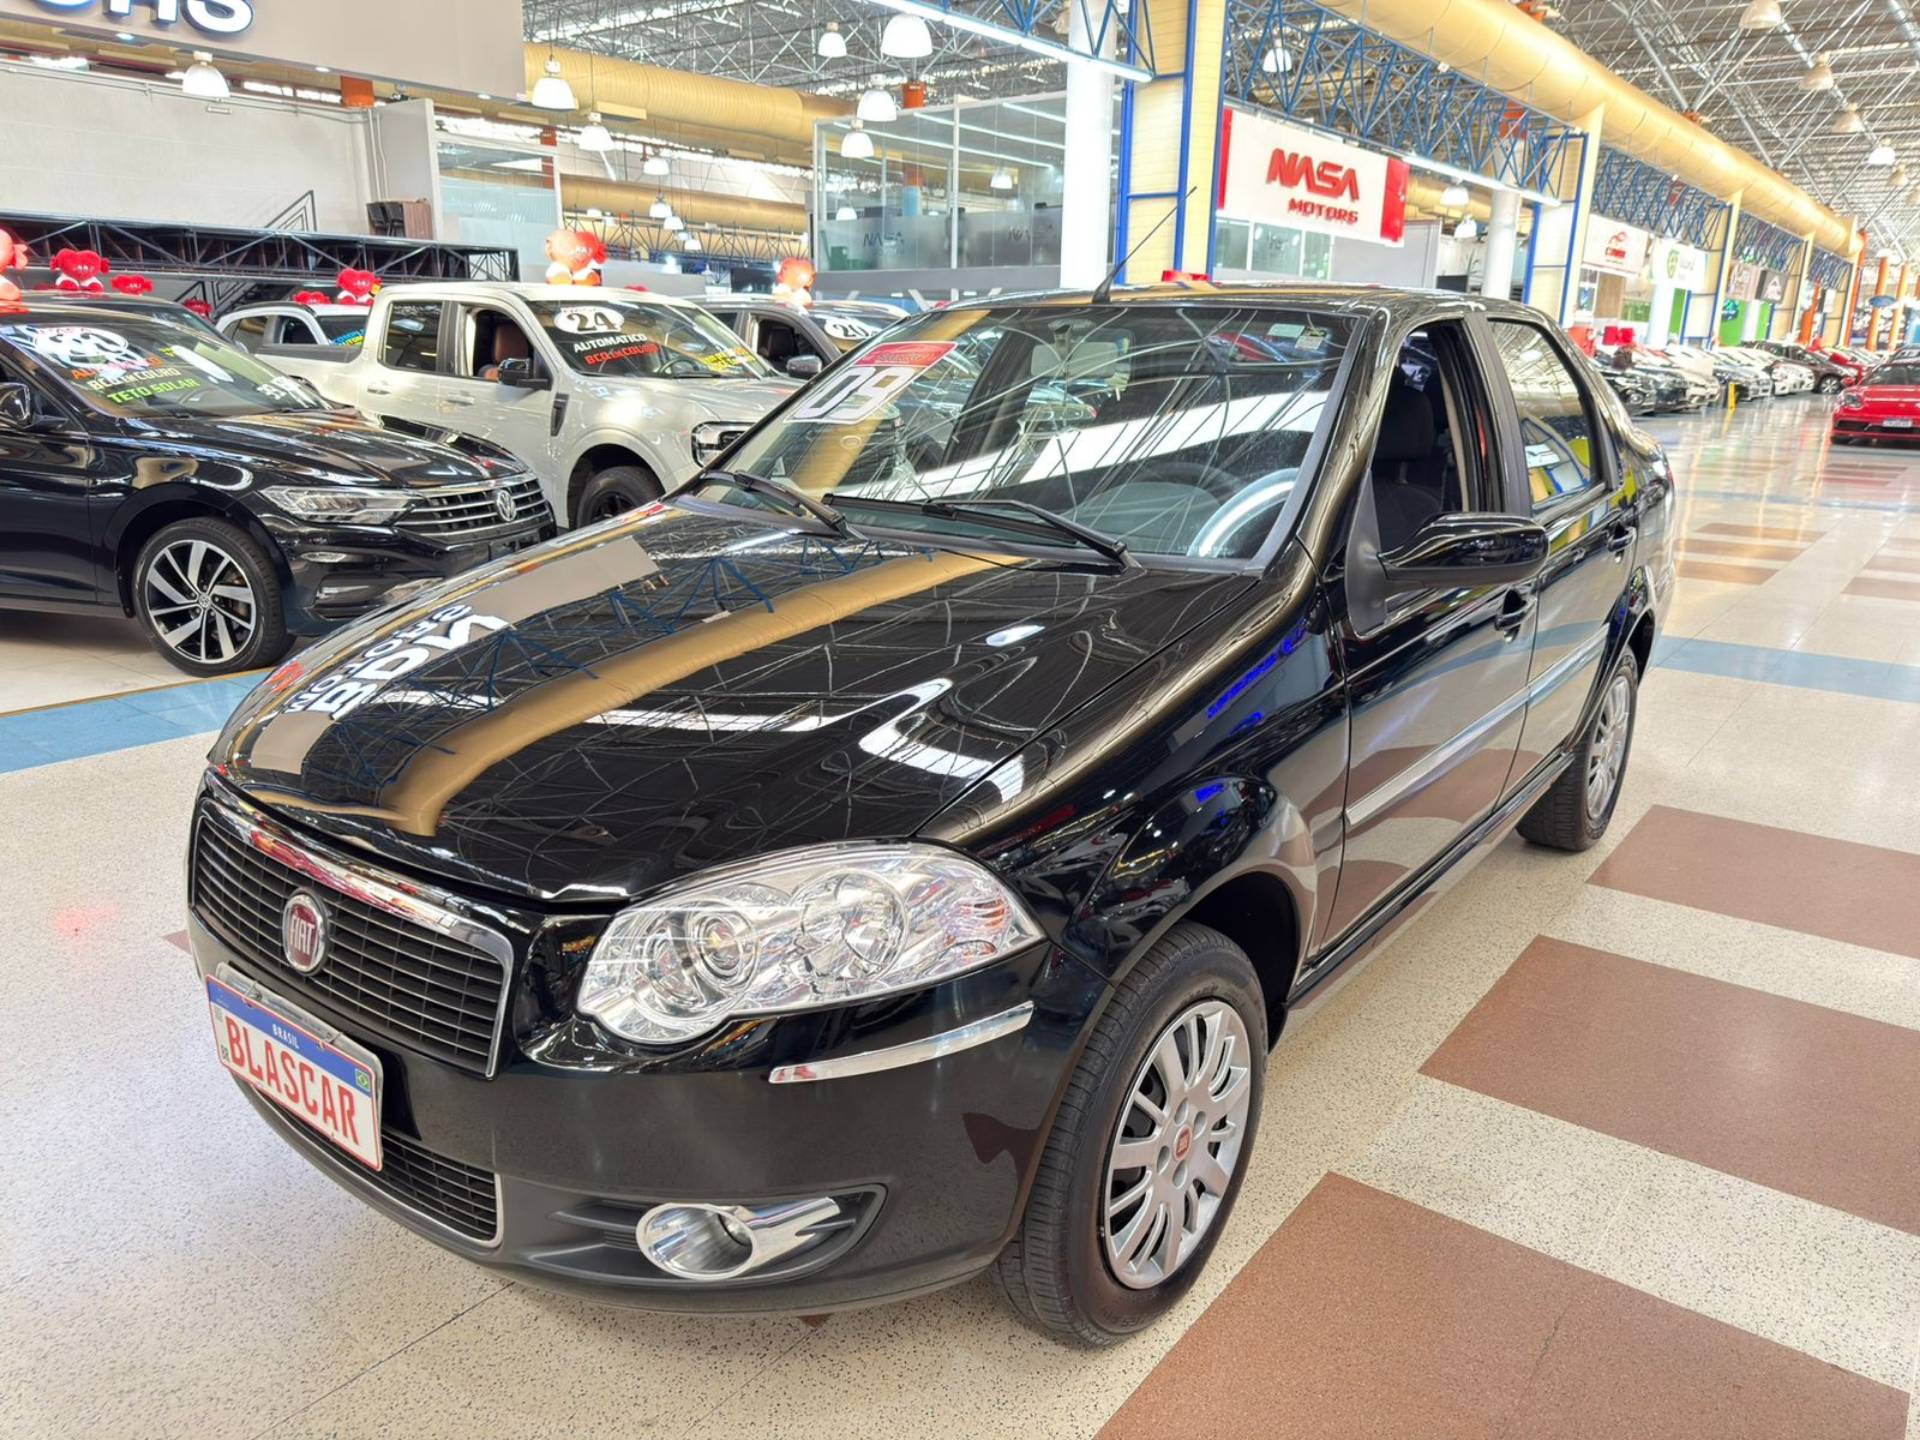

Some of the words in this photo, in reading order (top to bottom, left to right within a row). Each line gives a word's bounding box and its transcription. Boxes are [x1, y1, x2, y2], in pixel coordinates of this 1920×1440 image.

[1266, 148, 1360, 202] NASA
[1288, 198, 1359, 224] MOTORS
[567, 312, 619, 331] 24
[573, 334, 648, 353] AUTOMATICO
[134, 366, 182, 382] COURO
[107, 387, 151, 404] TETO
[150, 377, 201, 394] SOLAR
[792, 366, 917, 420] 09
[289, 913, 316, 956] FIAT
[271, 1023, 300, 1050] BRASIL
[225, 1015, 360, 1147] BLASCAR
